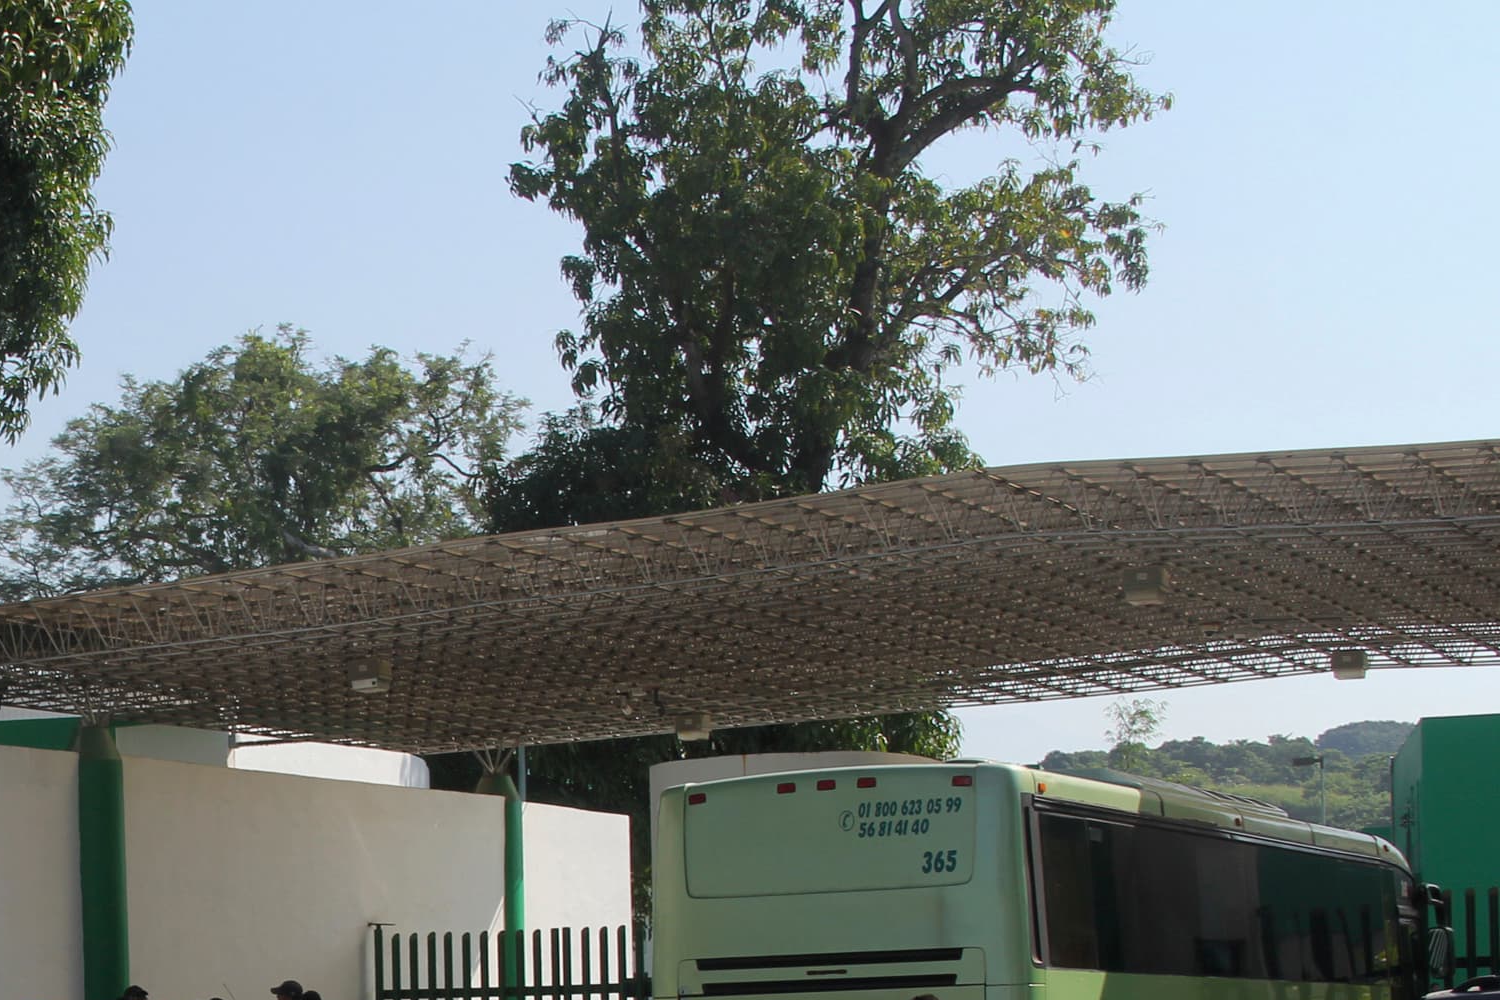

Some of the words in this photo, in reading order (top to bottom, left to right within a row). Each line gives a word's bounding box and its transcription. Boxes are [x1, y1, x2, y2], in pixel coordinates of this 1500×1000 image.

[858, 802, 871, 818] 01
[875, 801, 897, 817] 800
[901, 799, 922, 815] 623
[927, 798, 942, 814] 05
[946, 797, 962, 813] 99
[858, 822, 875, 838] 56
[879, 821, 892, 837] 81
[911, 818, 929, 835] 40
[922, 850, 957, 873] 365
